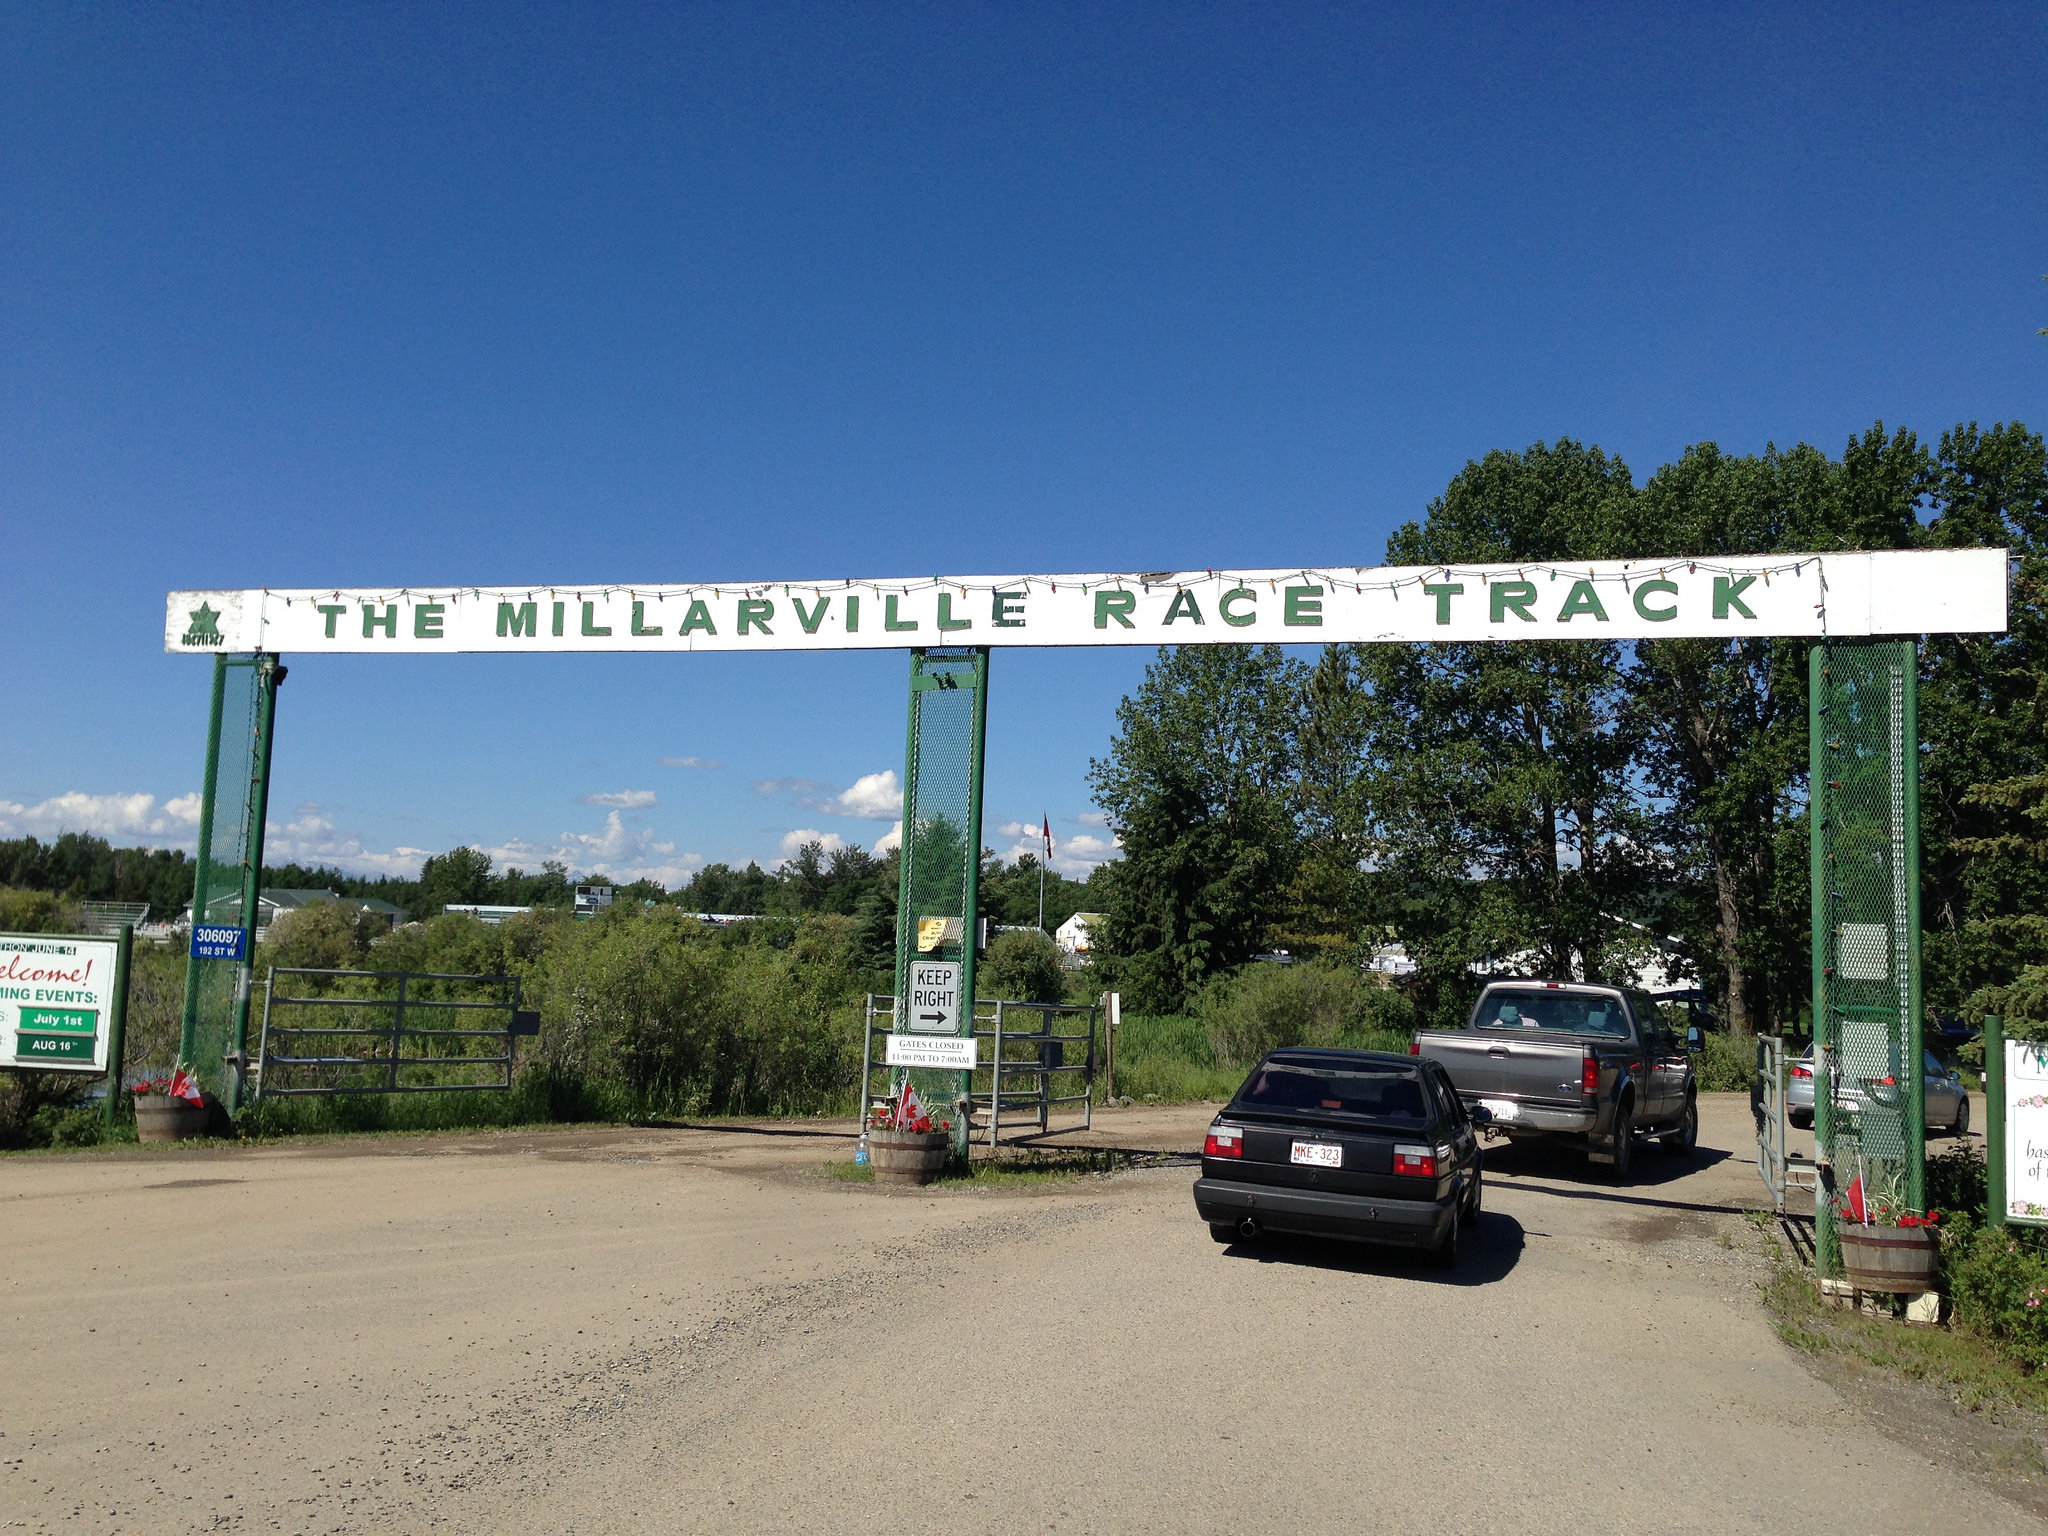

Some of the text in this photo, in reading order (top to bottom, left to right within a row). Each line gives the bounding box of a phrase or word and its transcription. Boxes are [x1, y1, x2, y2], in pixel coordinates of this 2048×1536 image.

[317, 576, 1757, 637] THE MILLARVILLE RACE TRACK
[197, 928, 241, 944] 306097
[199, 946, 236, 956] 192 ST W
[917, 969, 952, 985] KEEP
[36, 989, 97, 1004] EVENTS:
[914, 990, 954, 1006] RIGHT
[34, 1013, 59, 1026] July
[64, 1015, 82, 1025] 1st
[32, 1040, 56, 1050] AUG
[899, 1040, 964, 1050] GATES CLOSED
[892, 1053, 912, 1061] 11:00
[913, 1054, 926, 1062] PM
[928, 1055, 939, 1063] TO
